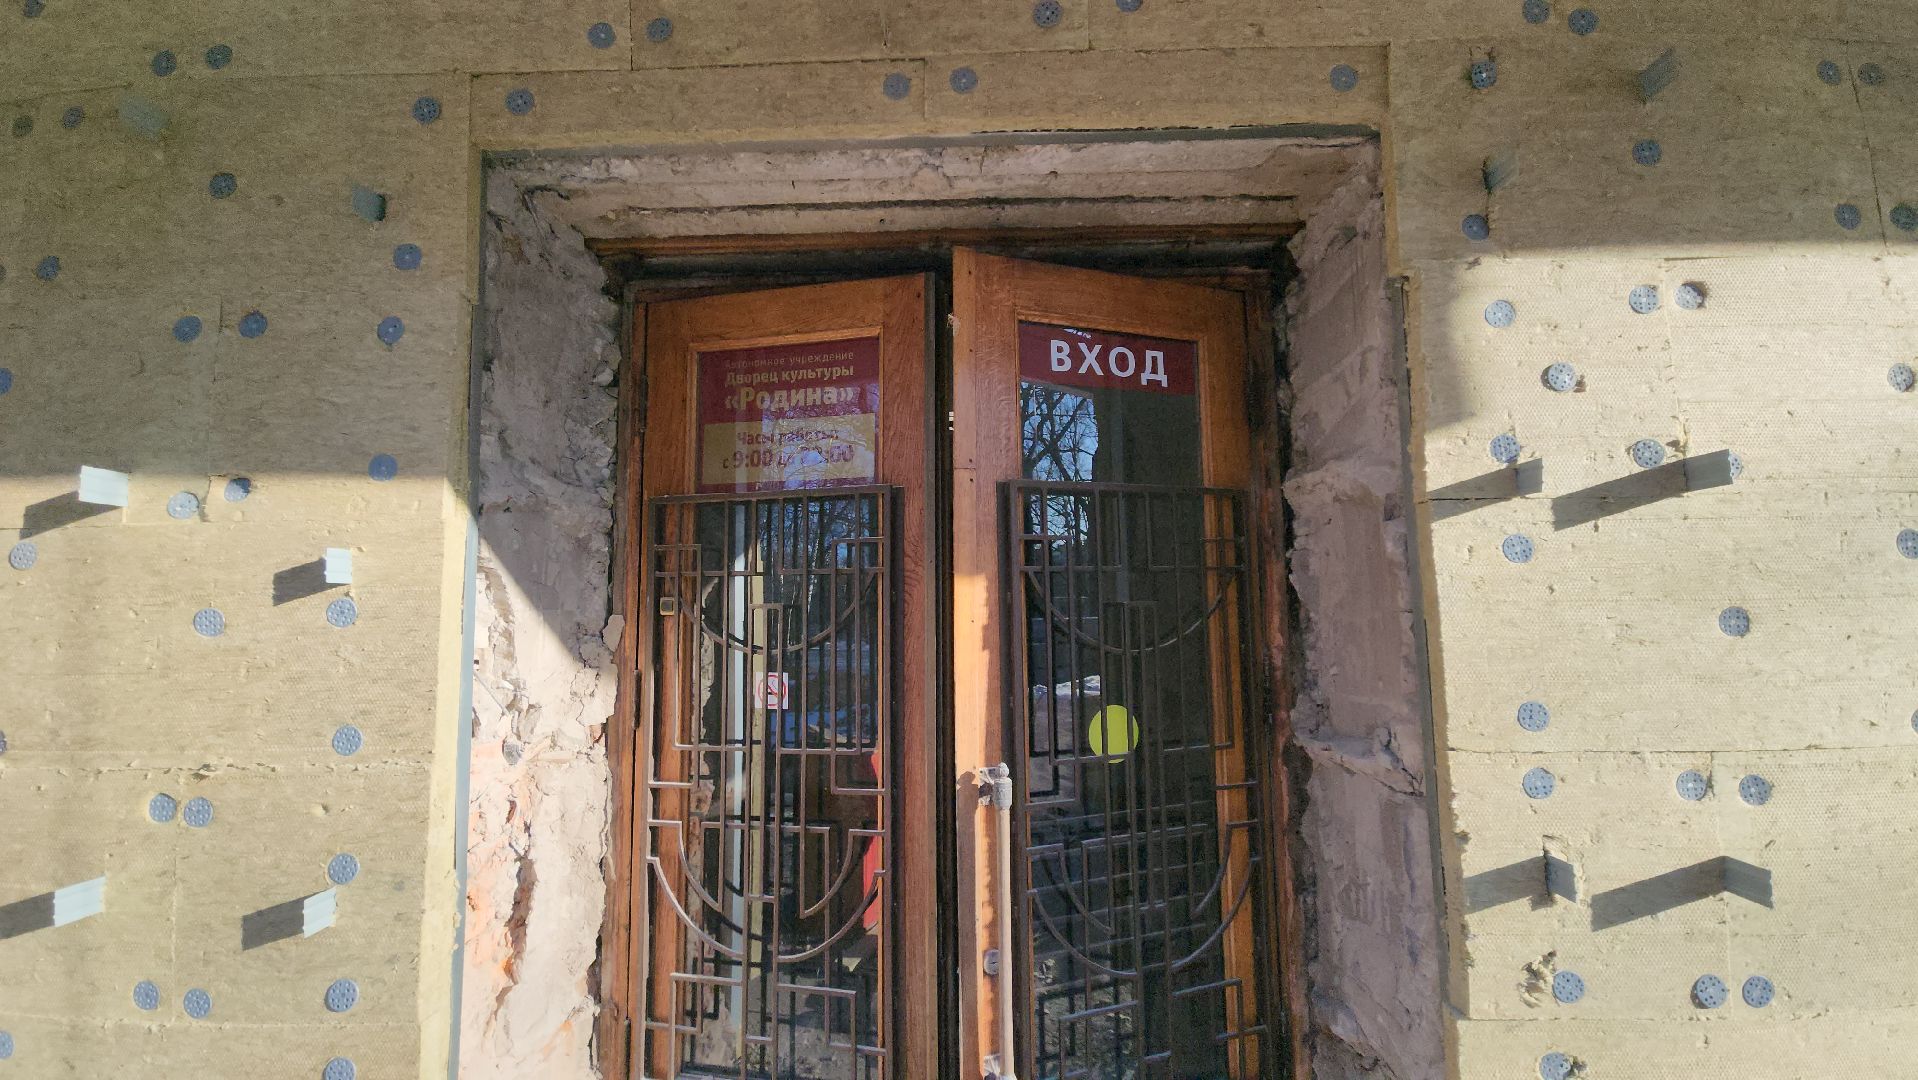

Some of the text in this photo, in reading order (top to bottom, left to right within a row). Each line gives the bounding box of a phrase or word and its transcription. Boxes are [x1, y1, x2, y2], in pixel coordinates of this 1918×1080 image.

[790, 352, 854, 366] учреждение
[1050, 340, 1168, 387] ВХОД
[725, 366, 854, 387] Дворец культуры
[725, 386, 854, 411] «Родина»
[737, 431, 775, 445] Часы
[723, 459, 729, 468] с
[734, 449, 772, 467] 9:00
